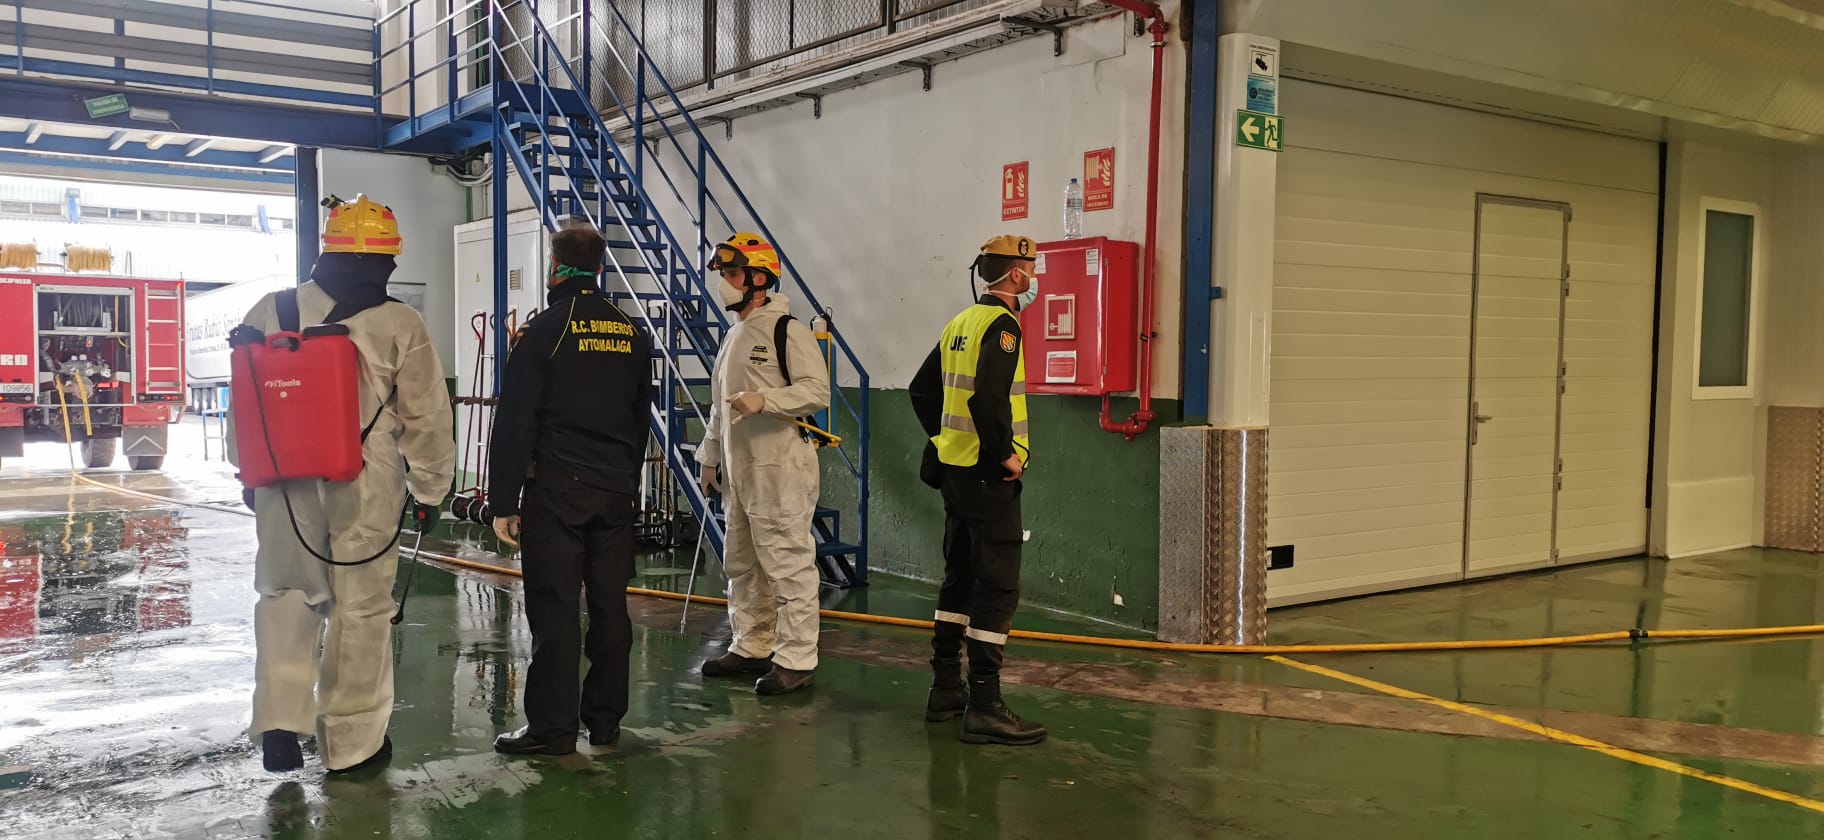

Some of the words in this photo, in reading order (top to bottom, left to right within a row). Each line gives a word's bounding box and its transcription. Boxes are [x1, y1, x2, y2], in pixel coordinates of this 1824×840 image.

[1003, 206, 1025, 215] EXTINTOR
[571, 320, 591, 334] R.C.
[578, 338, 632, 353] AYTOMALAGA
